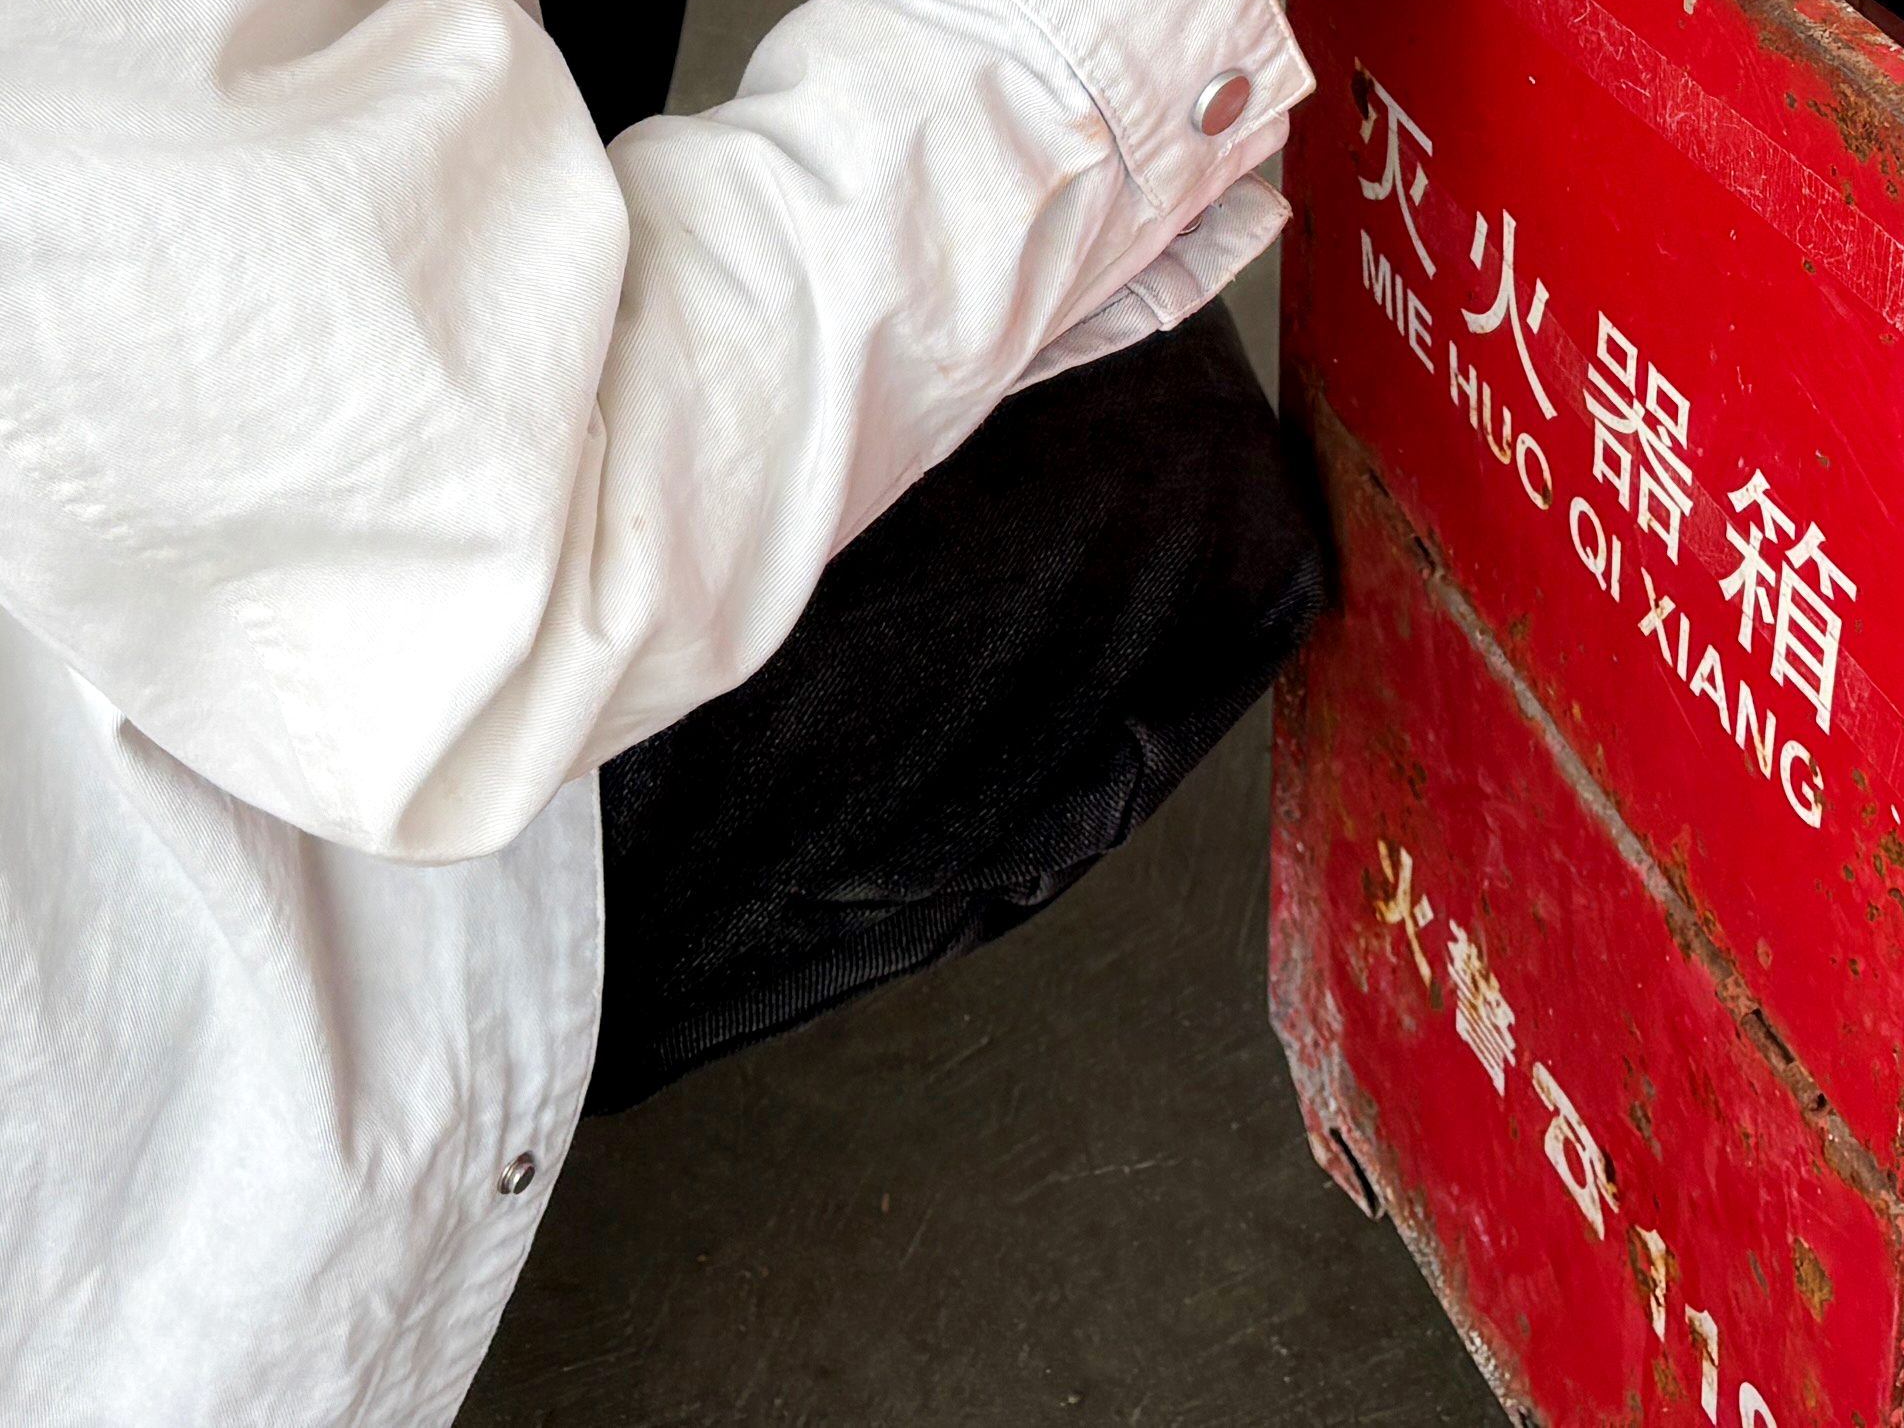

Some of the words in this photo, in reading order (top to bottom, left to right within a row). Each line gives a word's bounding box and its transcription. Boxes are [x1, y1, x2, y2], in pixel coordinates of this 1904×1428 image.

[1354, 55, 1857, 736] 灭火器箱
[1360, 228, 1435, 375] MIE
[1448, 339, 1554, 511] HUO
[1568, 496, 1622, 604] QI
[1636, 566, 1825, 830] XIANG
[1375, 838, 1517, 1098] 火警
